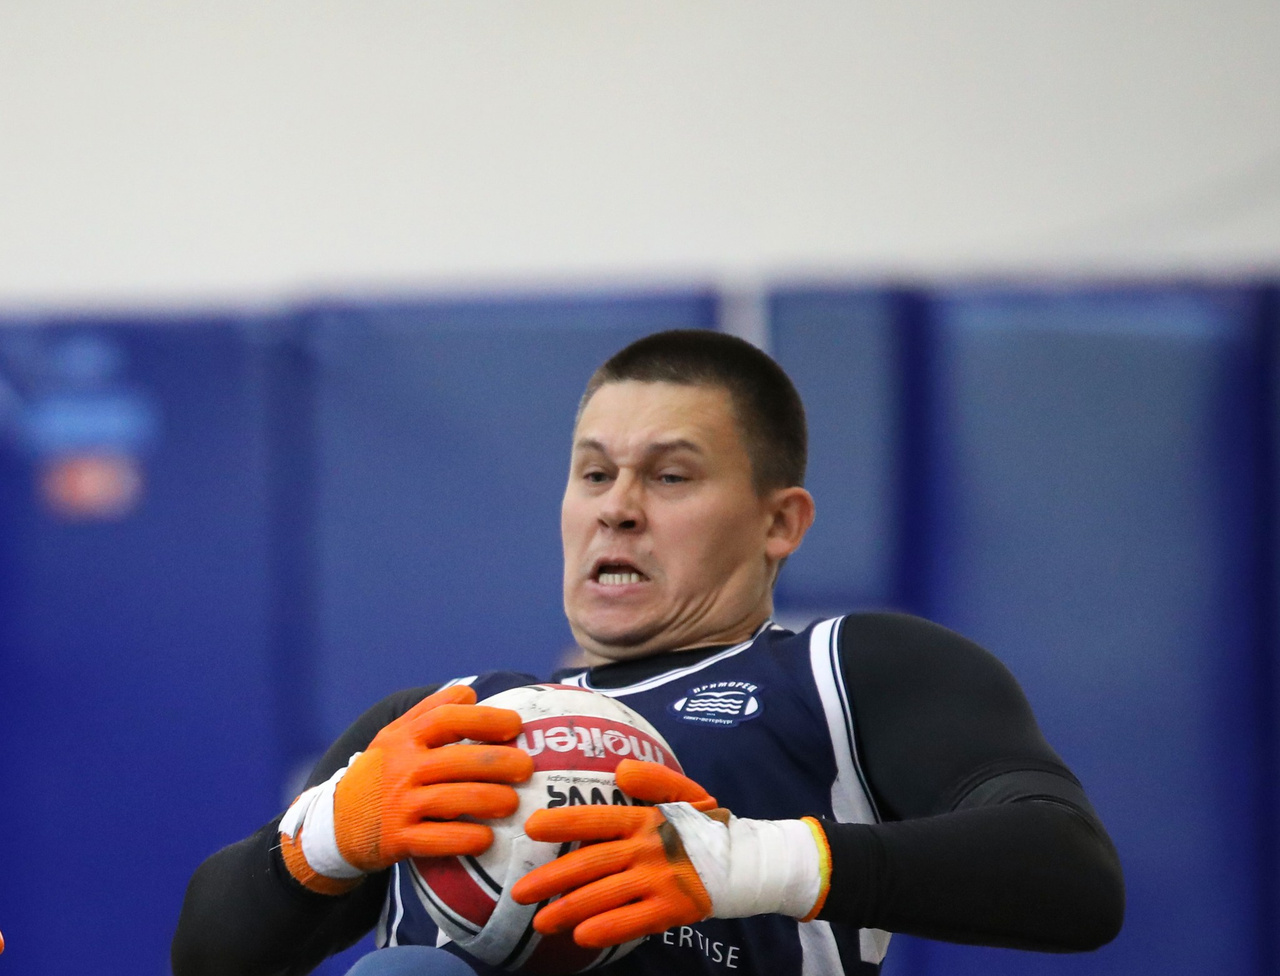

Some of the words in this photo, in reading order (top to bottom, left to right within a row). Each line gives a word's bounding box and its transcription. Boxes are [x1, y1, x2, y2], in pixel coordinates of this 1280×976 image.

[692, 681, 758, 694] ПРИМОРЕЦ
[516, 726, 665, 766] molten
[646, 925, 740, 969] ERTISE
